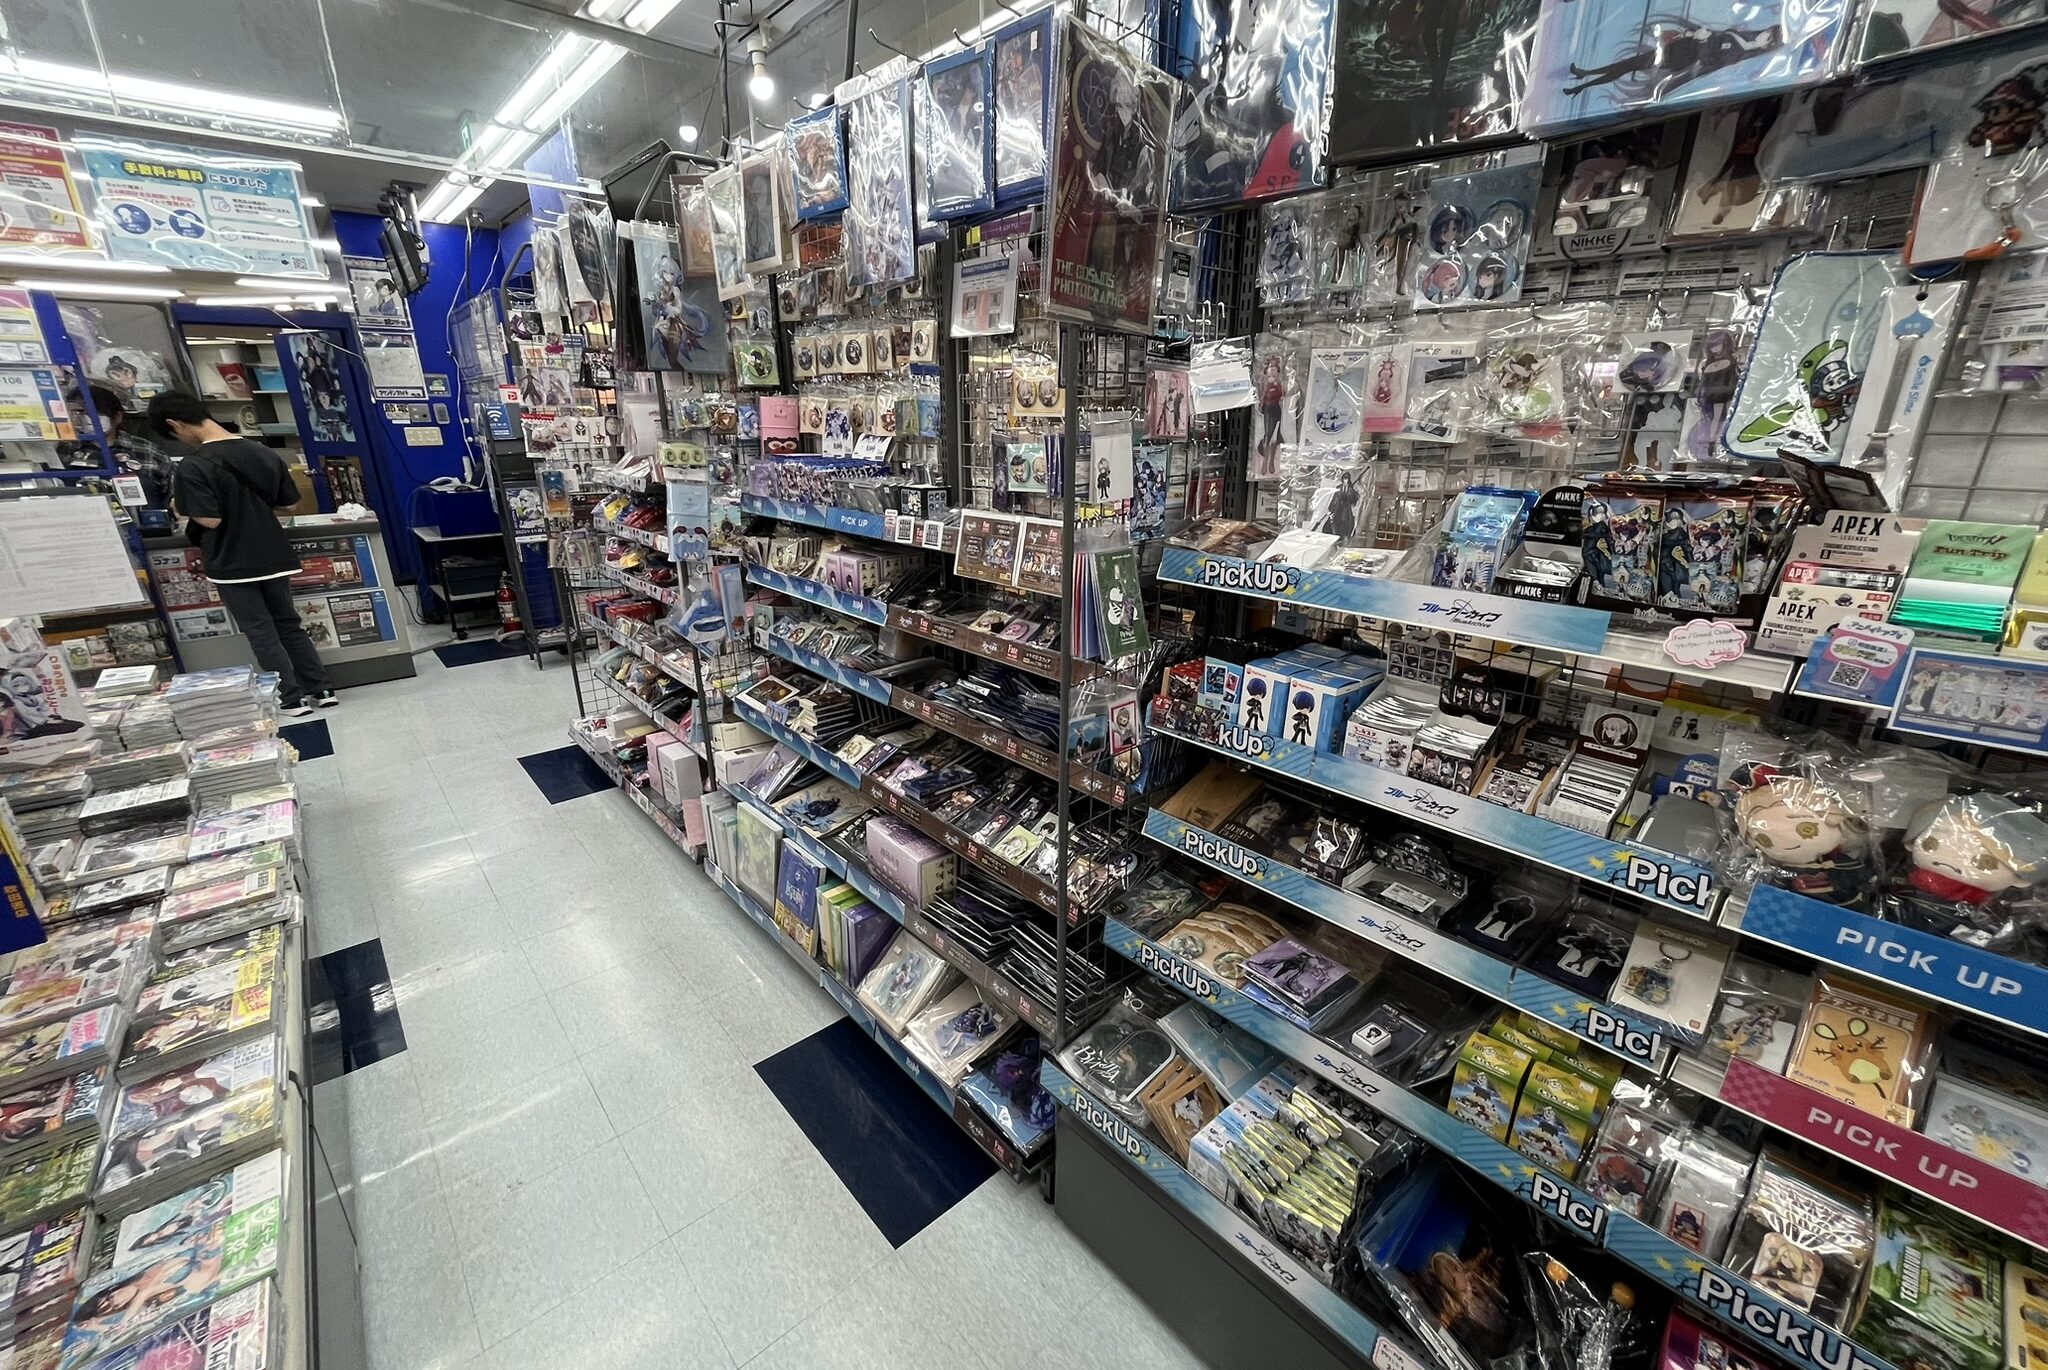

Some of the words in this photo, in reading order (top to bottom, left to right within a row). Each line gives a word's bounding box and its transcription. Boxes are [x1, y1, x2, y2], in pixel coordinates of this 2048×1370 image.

[209, 173, 268, 189] になりました
[1570, 233, 1616, 248] NIKKE
[1055, 258, 1074, 277] THE
[1075, 264, 1115, 288] COSMOS
[1911, 367, 1926, 390] Smile
[1555, 491, 1581, 502] NIKKE
[840, 515, 857, 526] PICK
[858, 517, 869, 528] UP
[1830, 515, 1886, 537] APEX
[1204, 560, 1289, 592] PickUp
[1787, 567, 1816, 580] APEX
[1514, 585, 1542, 598] NIKKE
[1418, 602, 1503, 622] ブルーアーカイブ
[1777, 602, 1817, 620] APEX
[1216, 724, 1264, 756] kUp
[1383, 786, 1460, 815] ブルーアーカイブ
[1184, 829, 1257, 874] PickUp
[1357, 915, 1427, 949] ブルーアーカイブ
[1140, 943, 1211, 998] PickUp
[1835, 926, 1939, 975] PICK
[1955, 965, 2023, 996] UP
[1314, 1054, 1381, 1094] ブルーアーカイブ
[1075, 1091, 1141, 1157] PickUp
[1807, 1106, 1902, 1161] PICK
[1918, 1155, 1979, 1189] UP
